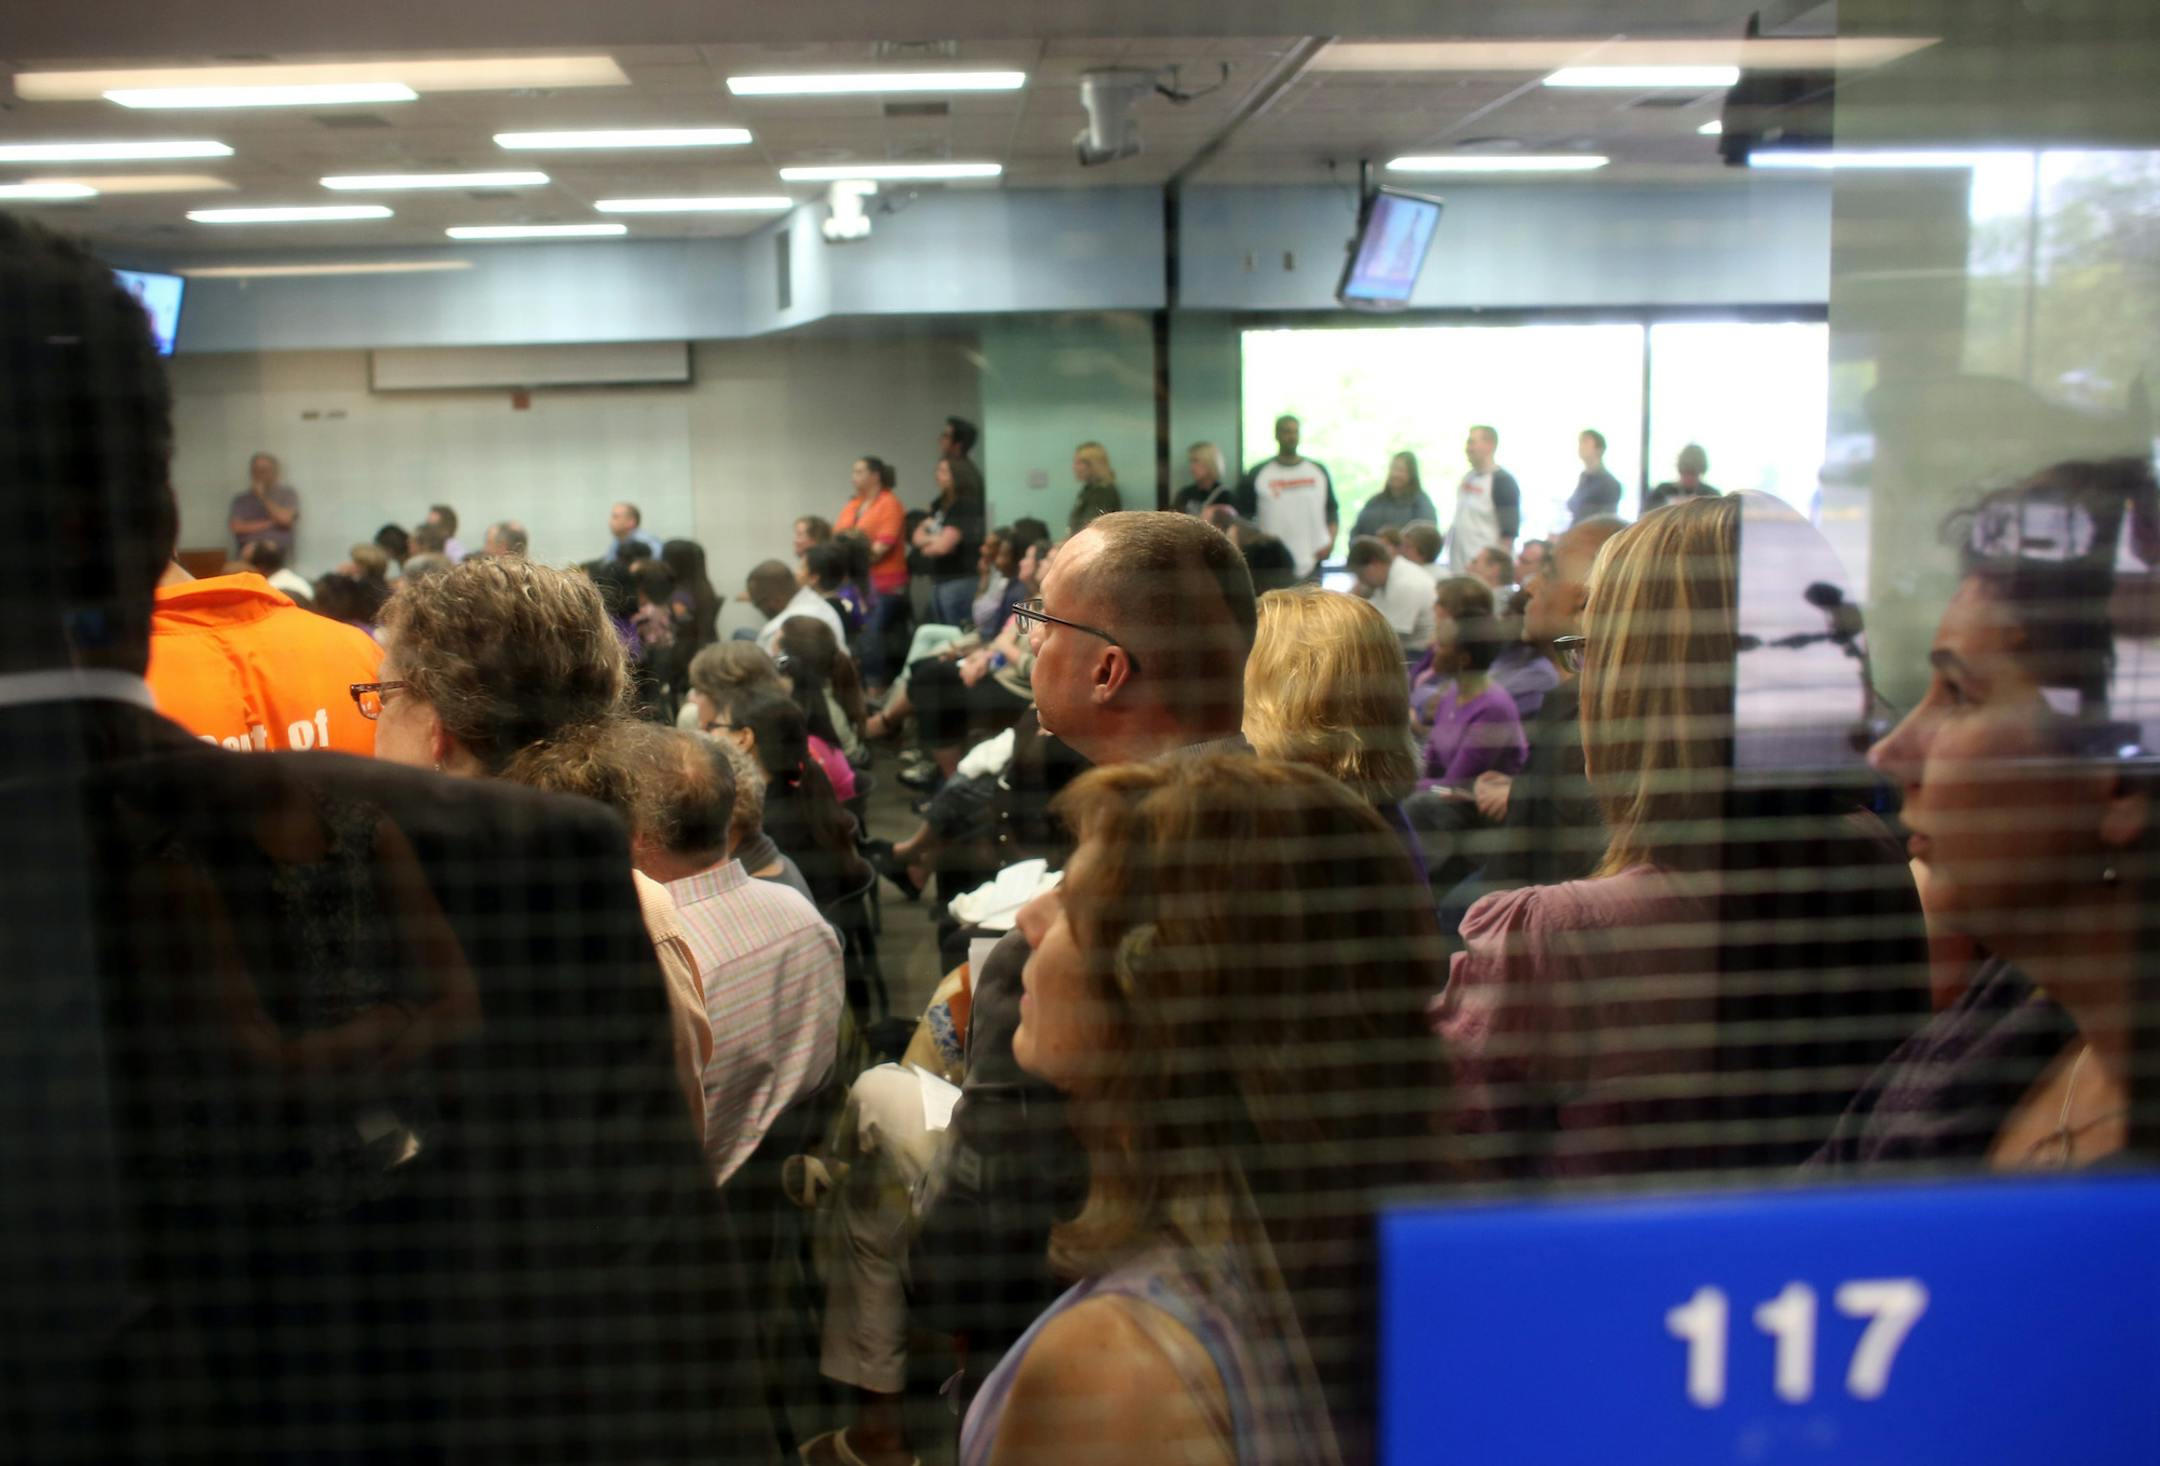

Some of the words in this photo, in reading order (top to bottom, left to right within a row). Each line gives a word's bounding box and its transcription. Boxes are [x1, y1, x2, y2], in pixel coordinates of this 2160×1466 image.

[196, 724, 267, 752] rt
[288, 708, 329, 751] of
[1665, 1278, 1929, 1408] 117
